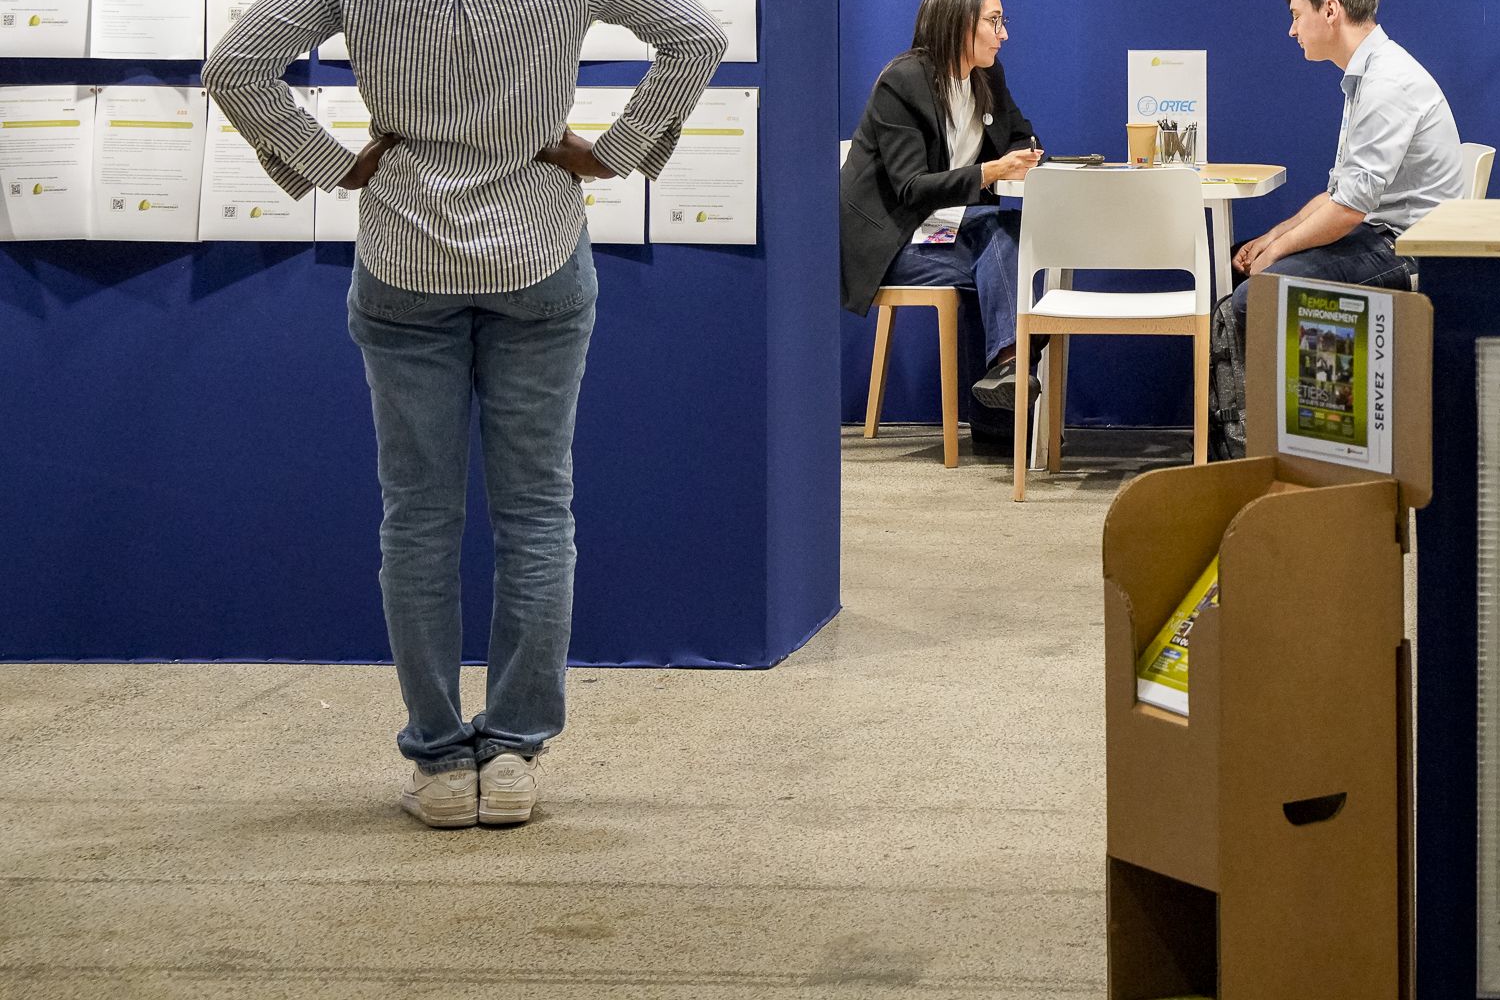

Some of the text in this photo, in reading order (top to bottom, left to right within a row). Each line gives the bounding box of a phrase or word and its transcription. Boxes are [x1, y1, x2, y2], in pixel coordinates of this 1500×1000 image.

[1160, 100, 1197, 112] ORTEC
[1298, 308, 1359, 324] ENVIRONNEMENT
[1375, 314, 1385, 430] SERVEZ VOUS
